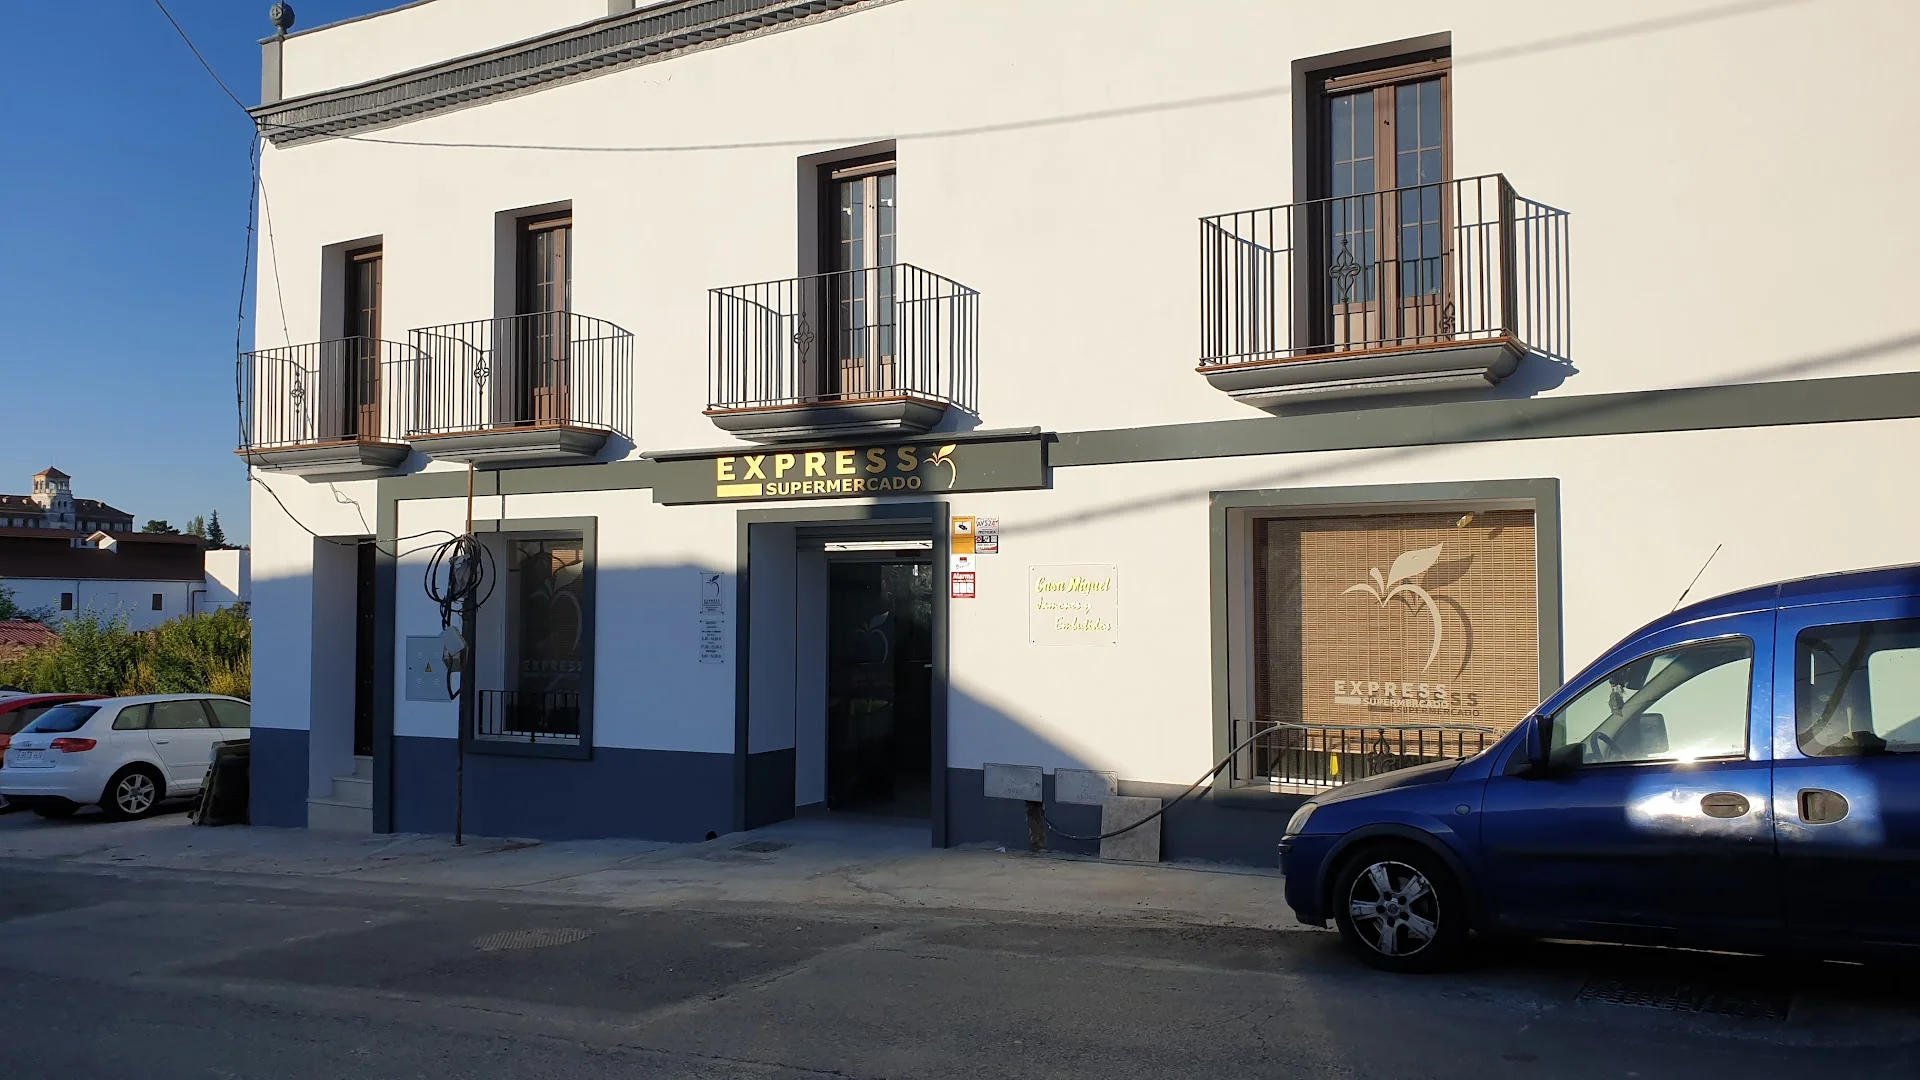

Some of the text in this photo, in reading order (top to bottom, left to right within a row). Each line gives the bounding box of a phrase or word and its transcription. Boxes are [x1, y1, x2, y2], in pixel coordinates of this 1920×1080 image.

[717, 446, 918, 481] EXPRESS
[766, 476, 921, 496] SUPERMERCADO
[1036, 576, 1111, 596] Casa Miguel
[1334, 680, 1447, 698] EXPRESS
[1363, 698, 1450, 708] SUPERMERCADO
